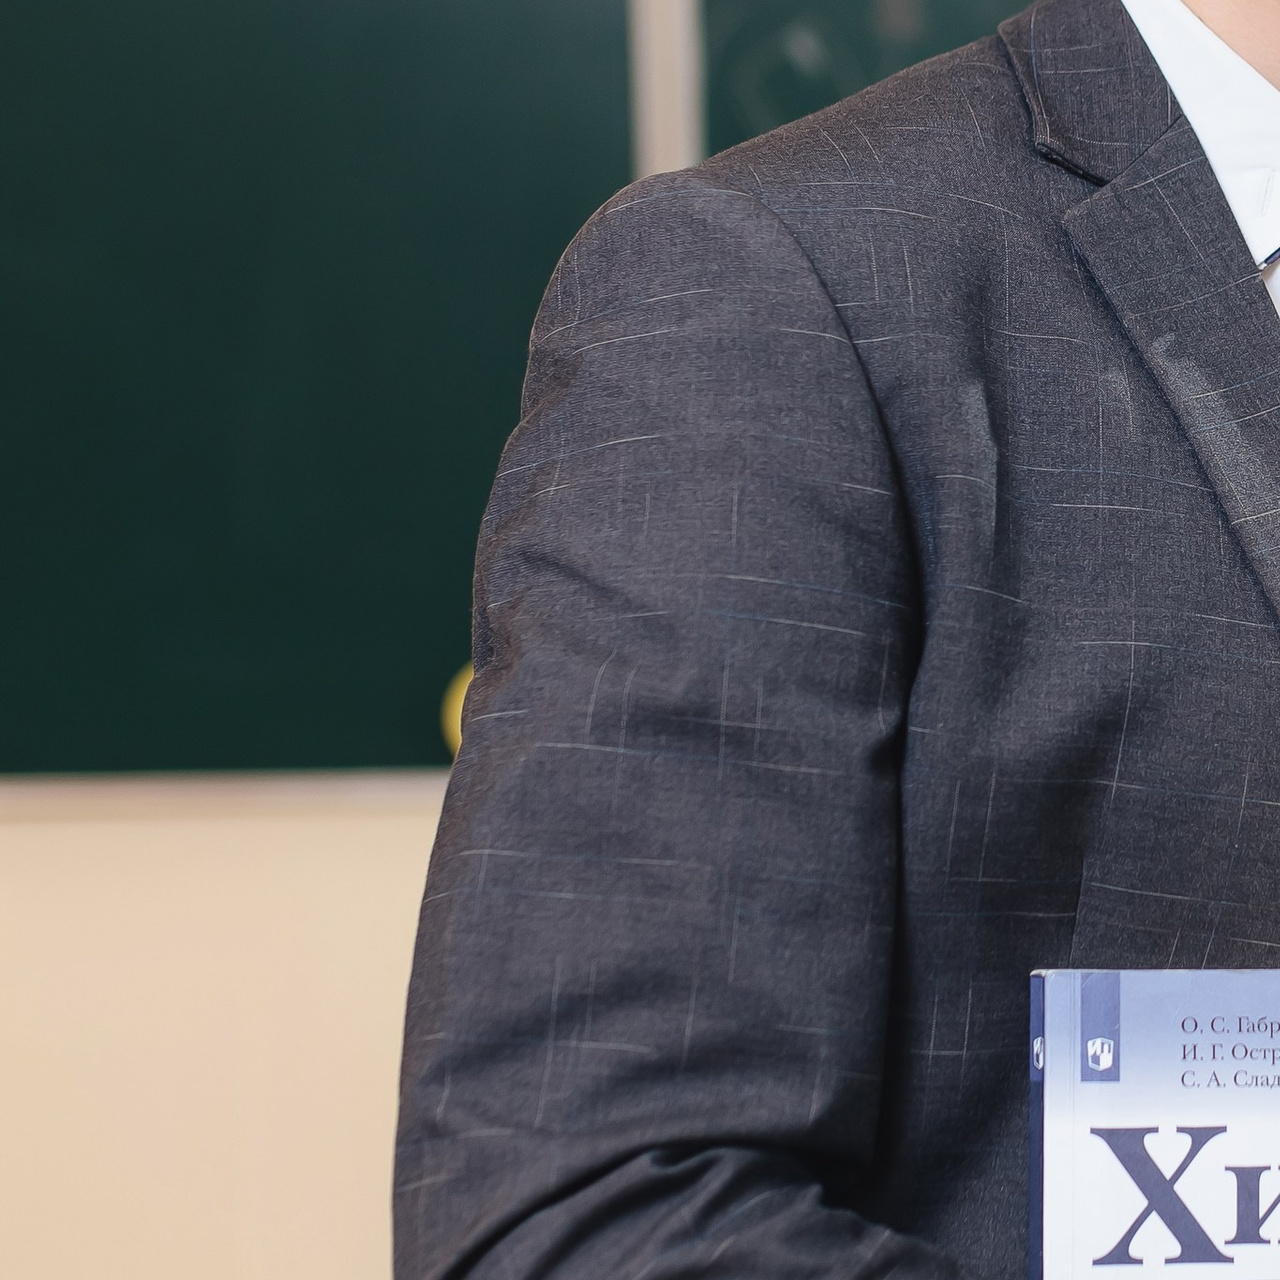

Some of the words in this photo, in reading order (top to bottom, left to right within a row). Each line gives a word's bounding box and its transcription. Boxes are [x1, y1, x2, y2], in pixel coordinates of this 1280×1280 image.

[1181, 1016, 1203, 1034] О.
[1210, 1016, 1230, 1034] С.
[1181, 1043, 1204, 1061] И.
[1211, 1043, 1225, 1061] Г.
[1181, 1070, 1200, 1088] С.
[1207, 1070, 1227, 1088] А.
